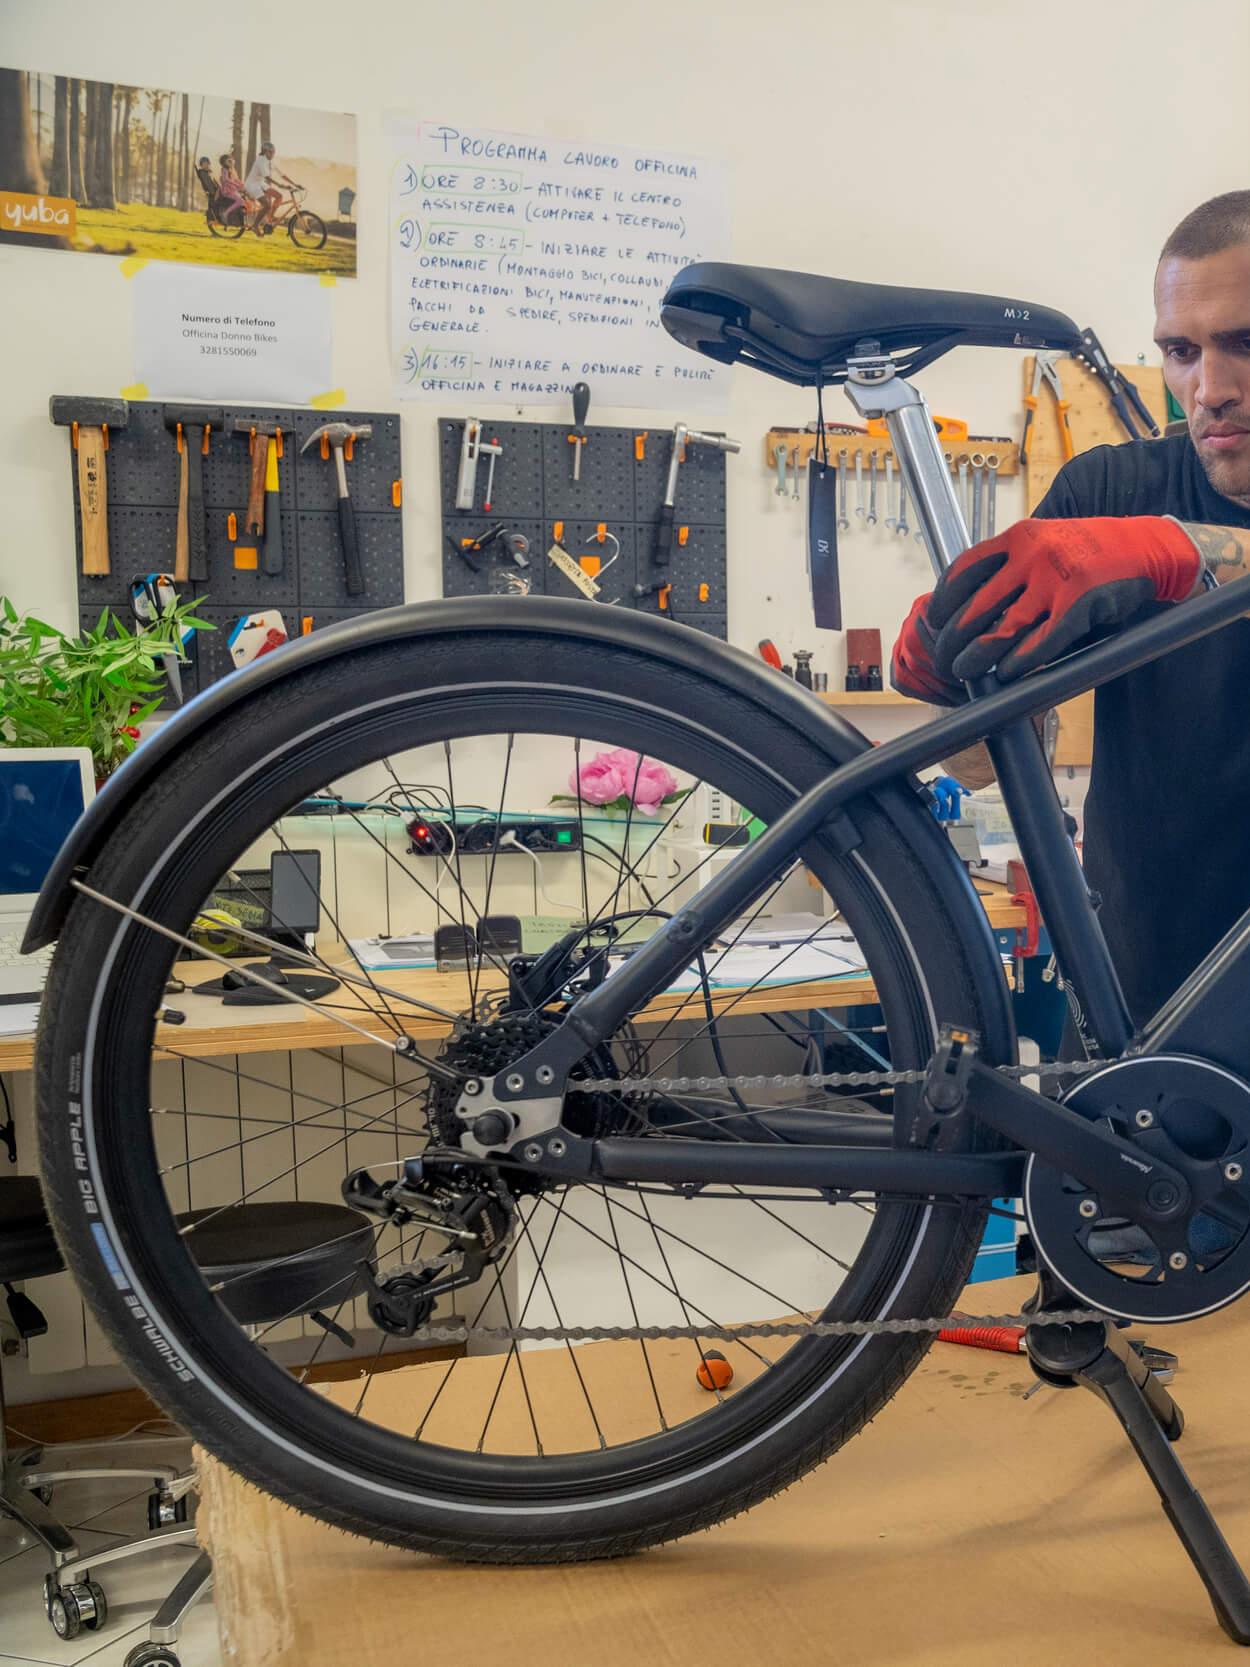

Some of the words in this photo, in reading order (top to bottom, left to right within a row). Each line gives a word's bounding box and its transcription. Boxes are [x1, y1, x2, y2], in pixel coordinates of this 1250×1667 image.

[428, 126, 548, 162] PROGRAMMA
[563, 152, 619, 169] LAVORO
[634, 159, 697, 180] OFFICINA
[422, 175, 459, 189] ORE
[473, 176, 519, 193] 8:30
[538, 182, 604, 201] ATTIVARE
[613, 191, 624, 202] IL
[631, 192, 682, 208] CENTRO
[5, 198, 69, 228] yuba
[428, 231, 459, 246] ORE
[541, 241, 607, 258] INIZIARE
[618, 248, 634, 259] LE
[420, 256, 488, 271] ORDINARIE
[408, 297, 452, 312] PACCHI
[181, 313, 221, 324] Numero
[223, 316, 232, 325] di
[234, 317, 276, 328] Telefono
[182, 328, 219, 340] Officina
[254, 333, 278, 343] Bikes
[582, 363, 644, 377] ORDINARE
[421, 380, 486, 392] OFFICINA
[68, 1101, 88, 1171] APPLE
[78, 1179, 98, 1214] BIG
[123, 1294, 196, 1382] SCHWALBE
